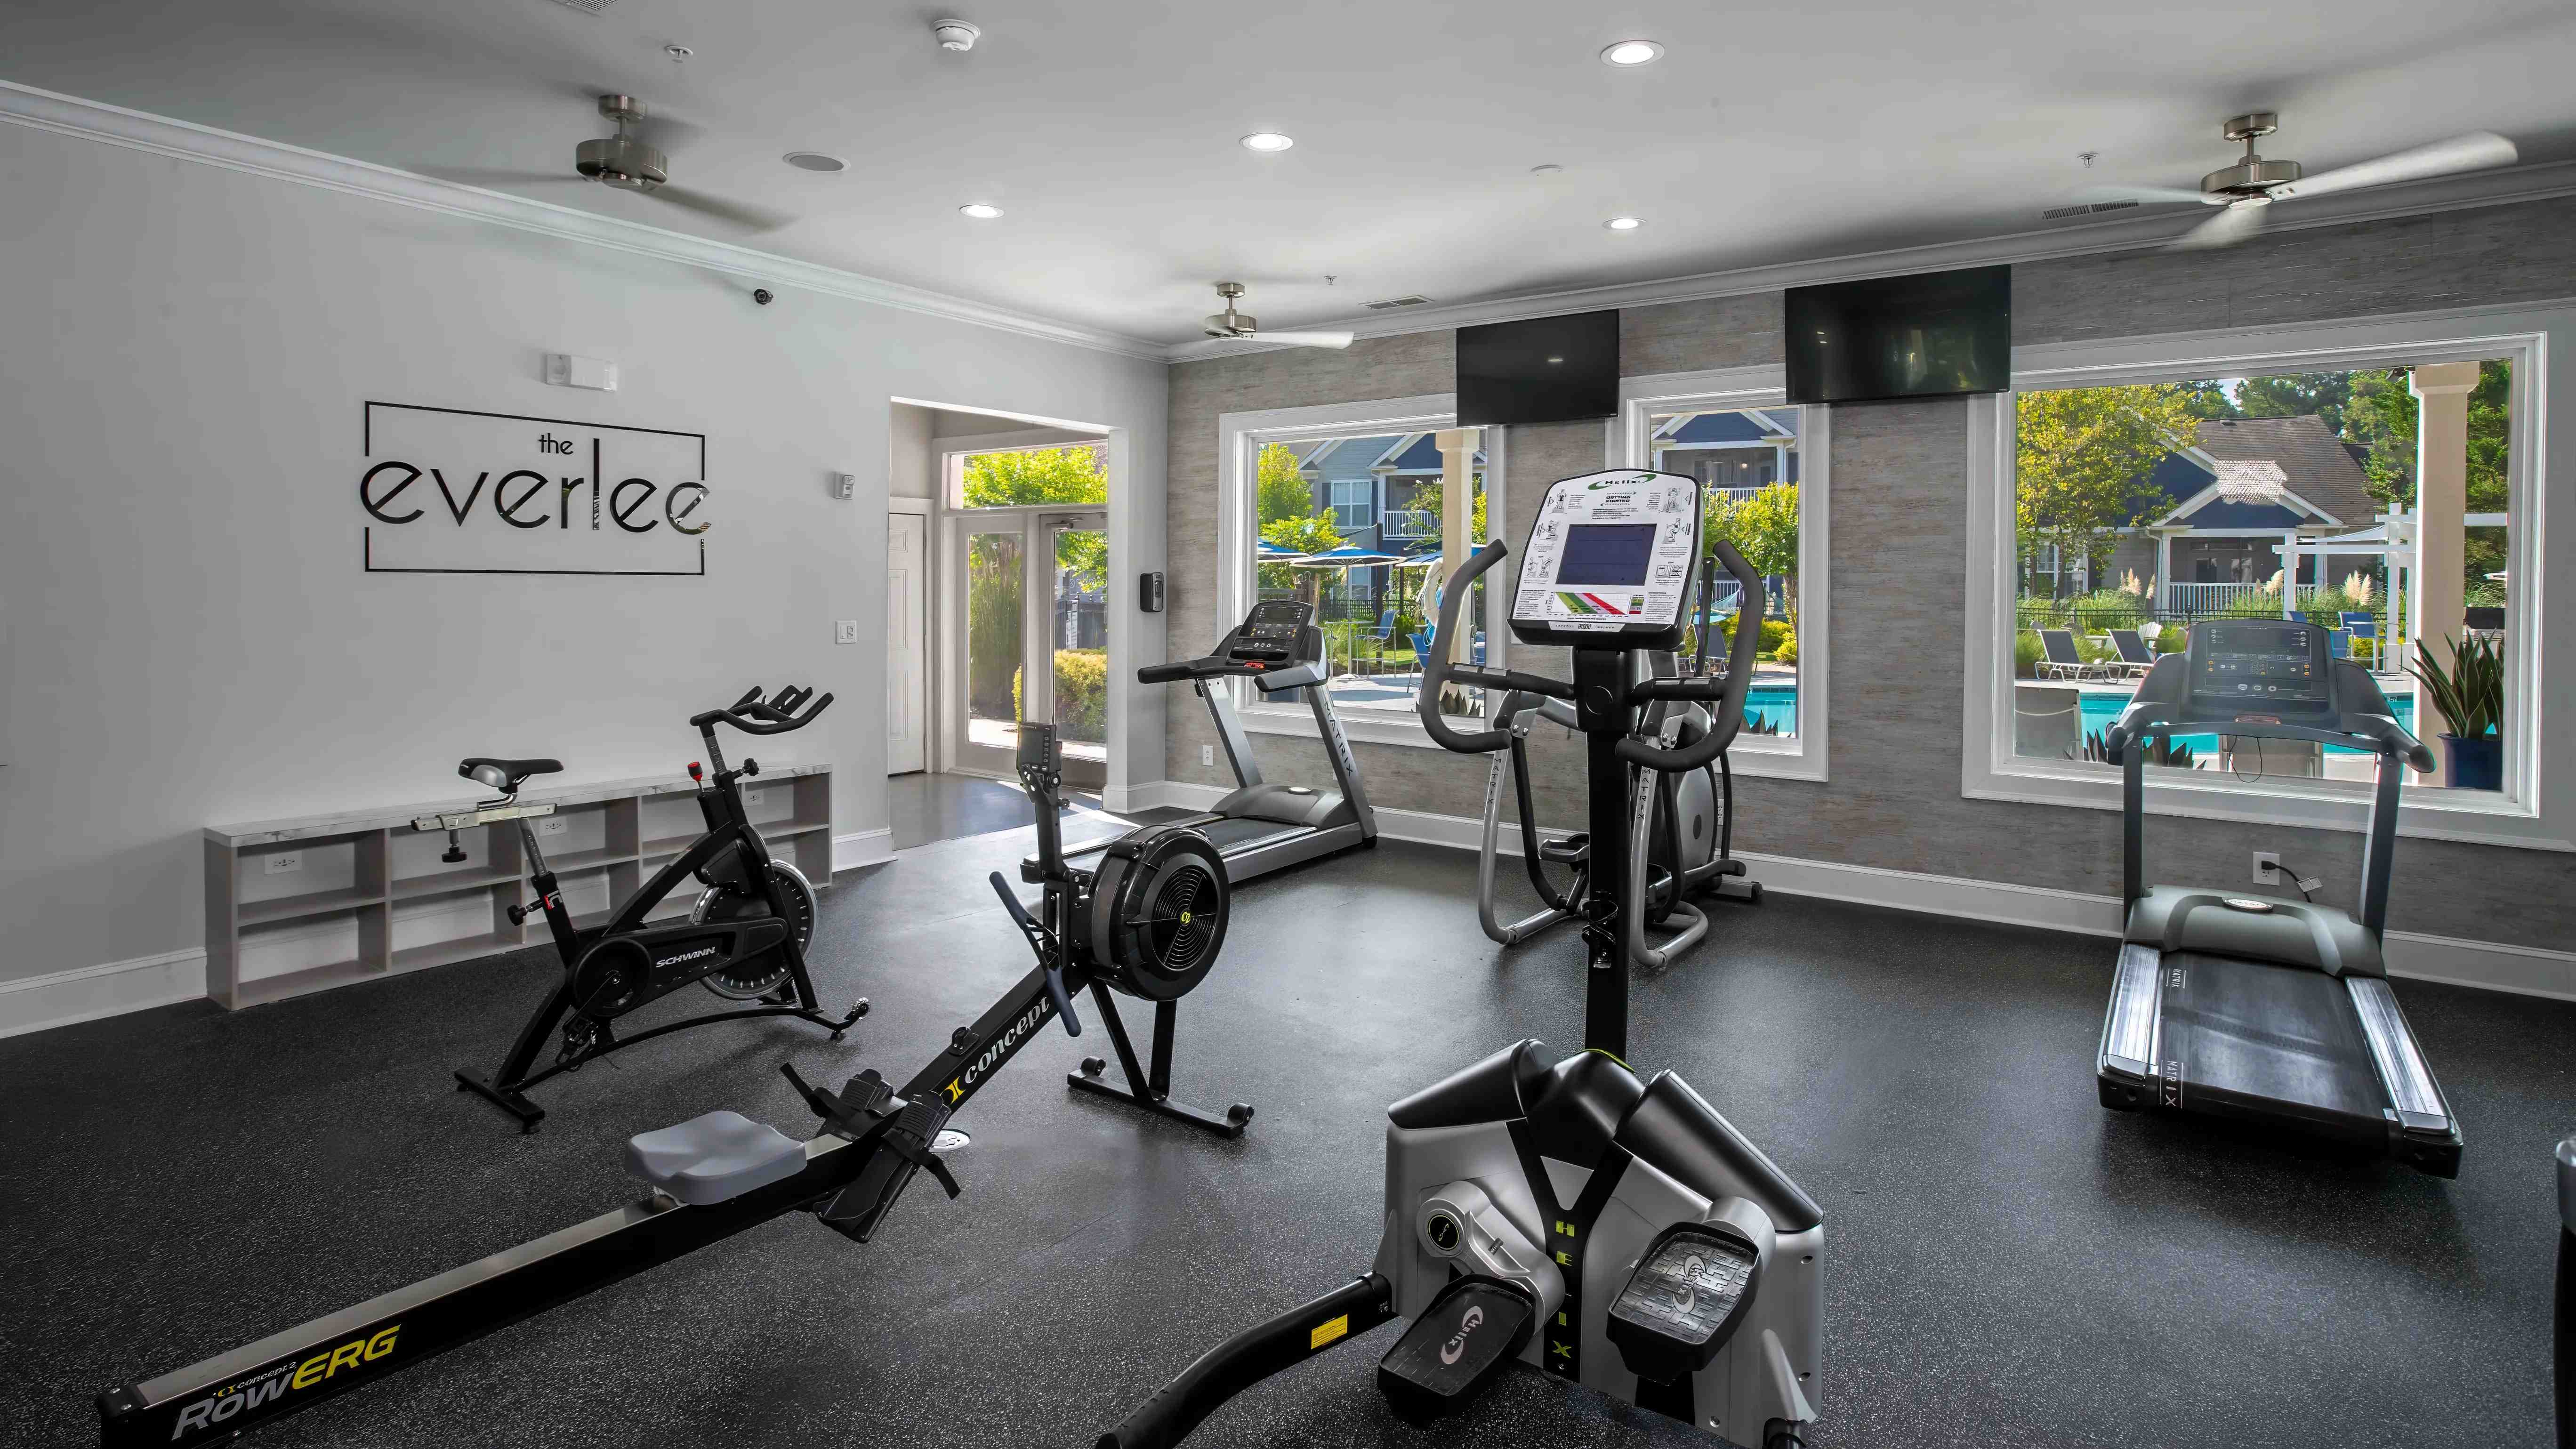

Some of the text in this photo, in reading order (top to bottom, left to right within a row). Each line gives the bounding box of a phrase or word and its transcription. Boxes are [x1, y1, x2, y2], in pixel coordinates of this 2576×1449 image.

[538, 433, 574, 455] the
[360, 438, 712, 535] everlee
[1324, 701, 1353, 776] MATRIX
[1487, 758, 1502, 804] MATRIX
[1638, 768, 1650, 820] MATRIX
[655, 946, 716, 968] SCHWINN
[2171, 968, 2182, 988] MATRIX
[965, 996, 1050, 1084] concept
[2165, 1060, 2177, 1106] MATRIX
[1552, 1220, 1575, 1358] HEIX
[237, 1365, 288, 1389] concept
